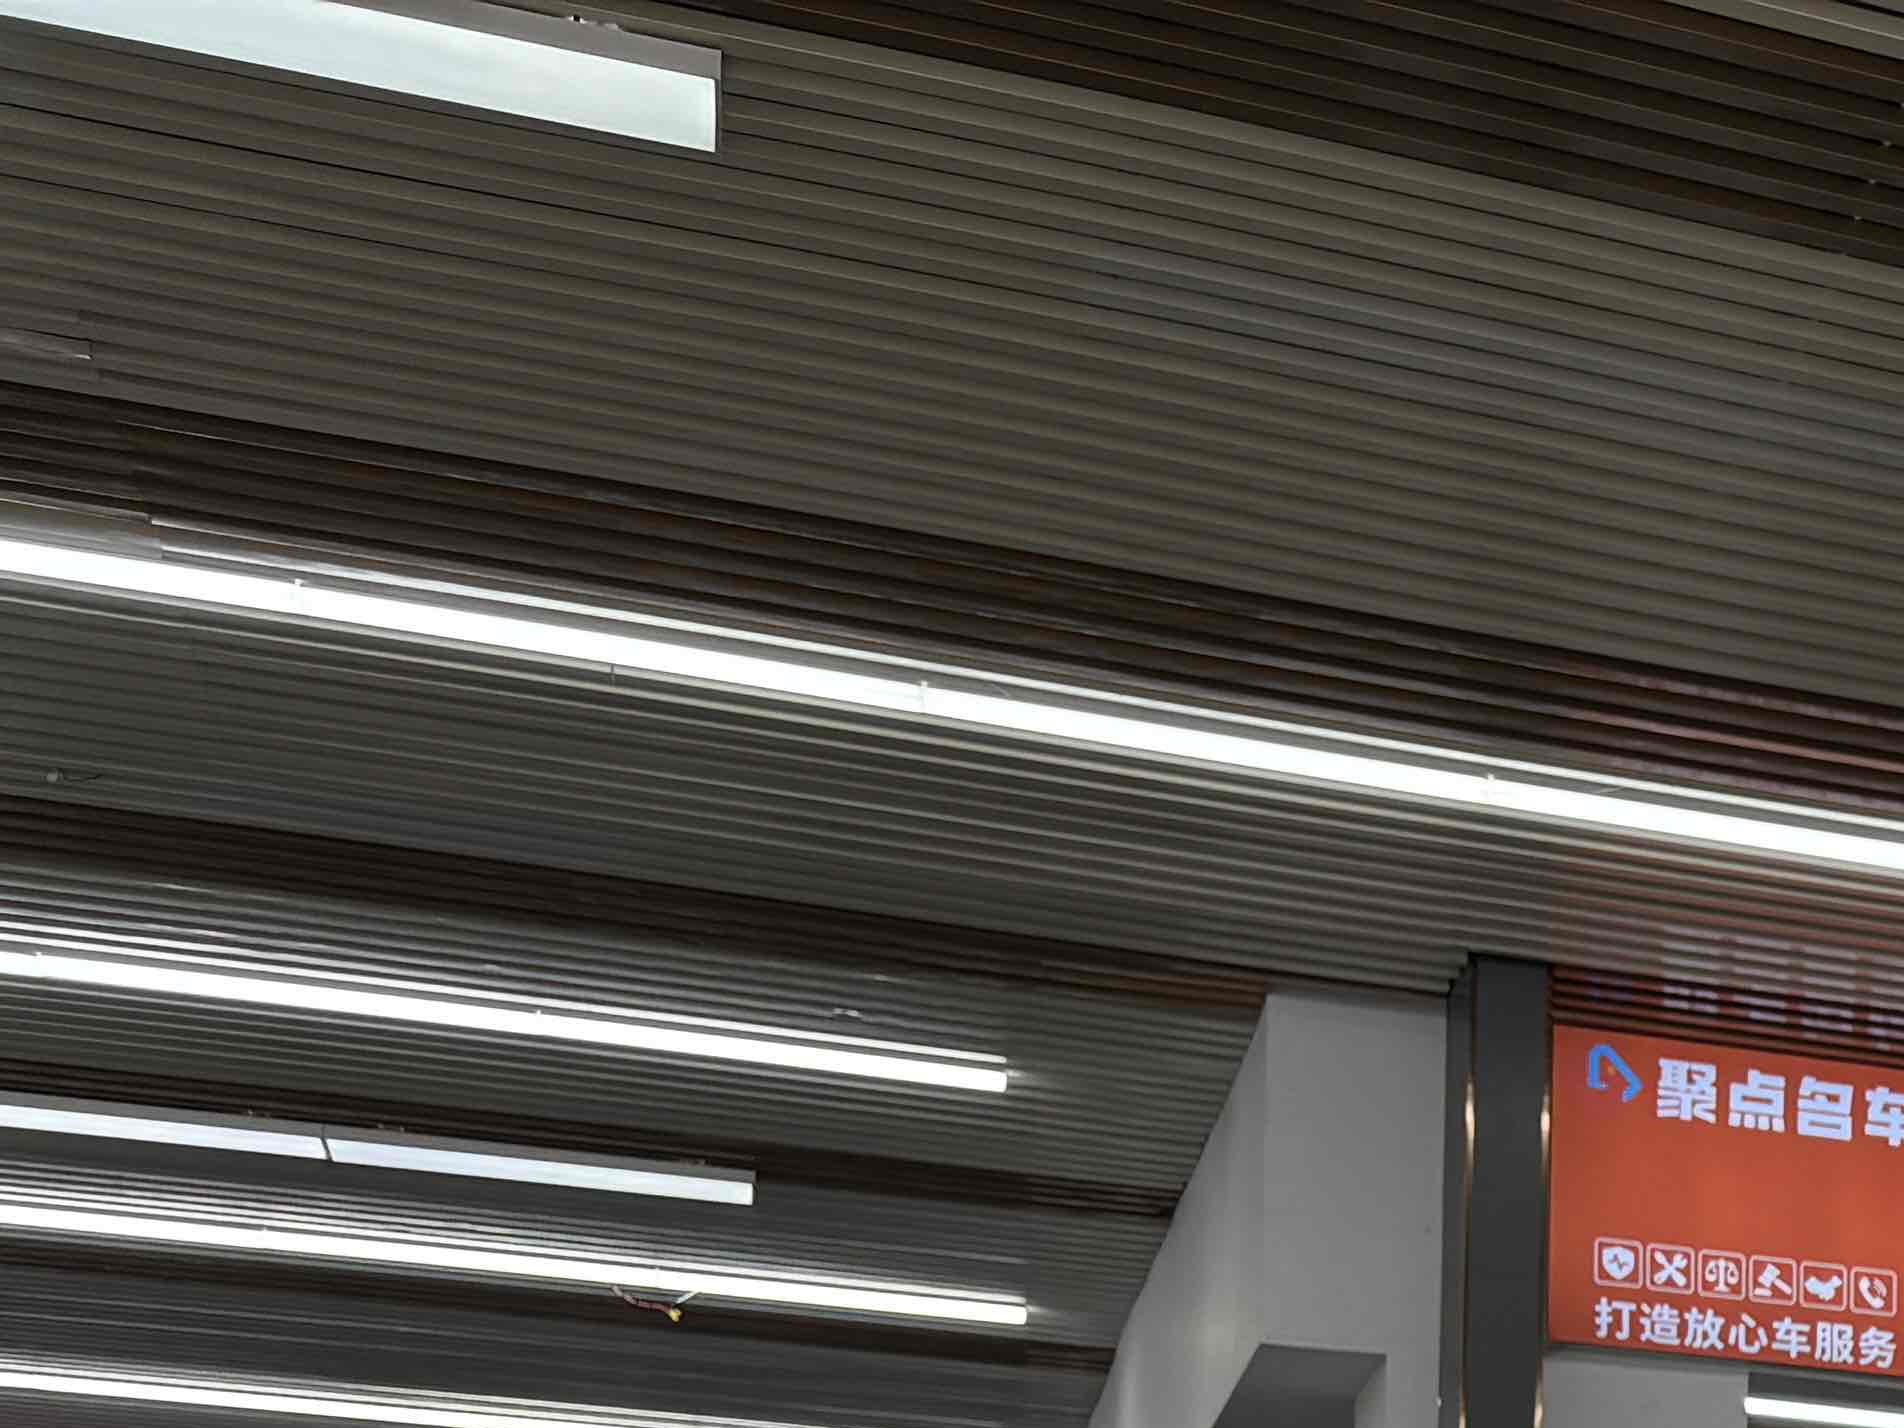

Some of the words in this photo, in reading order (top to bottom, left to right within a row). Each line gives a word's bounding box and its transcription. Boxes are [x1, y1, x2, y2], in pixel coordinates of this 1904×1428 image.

[1594, 1296, 1897, 1369] 打造放心车服务
